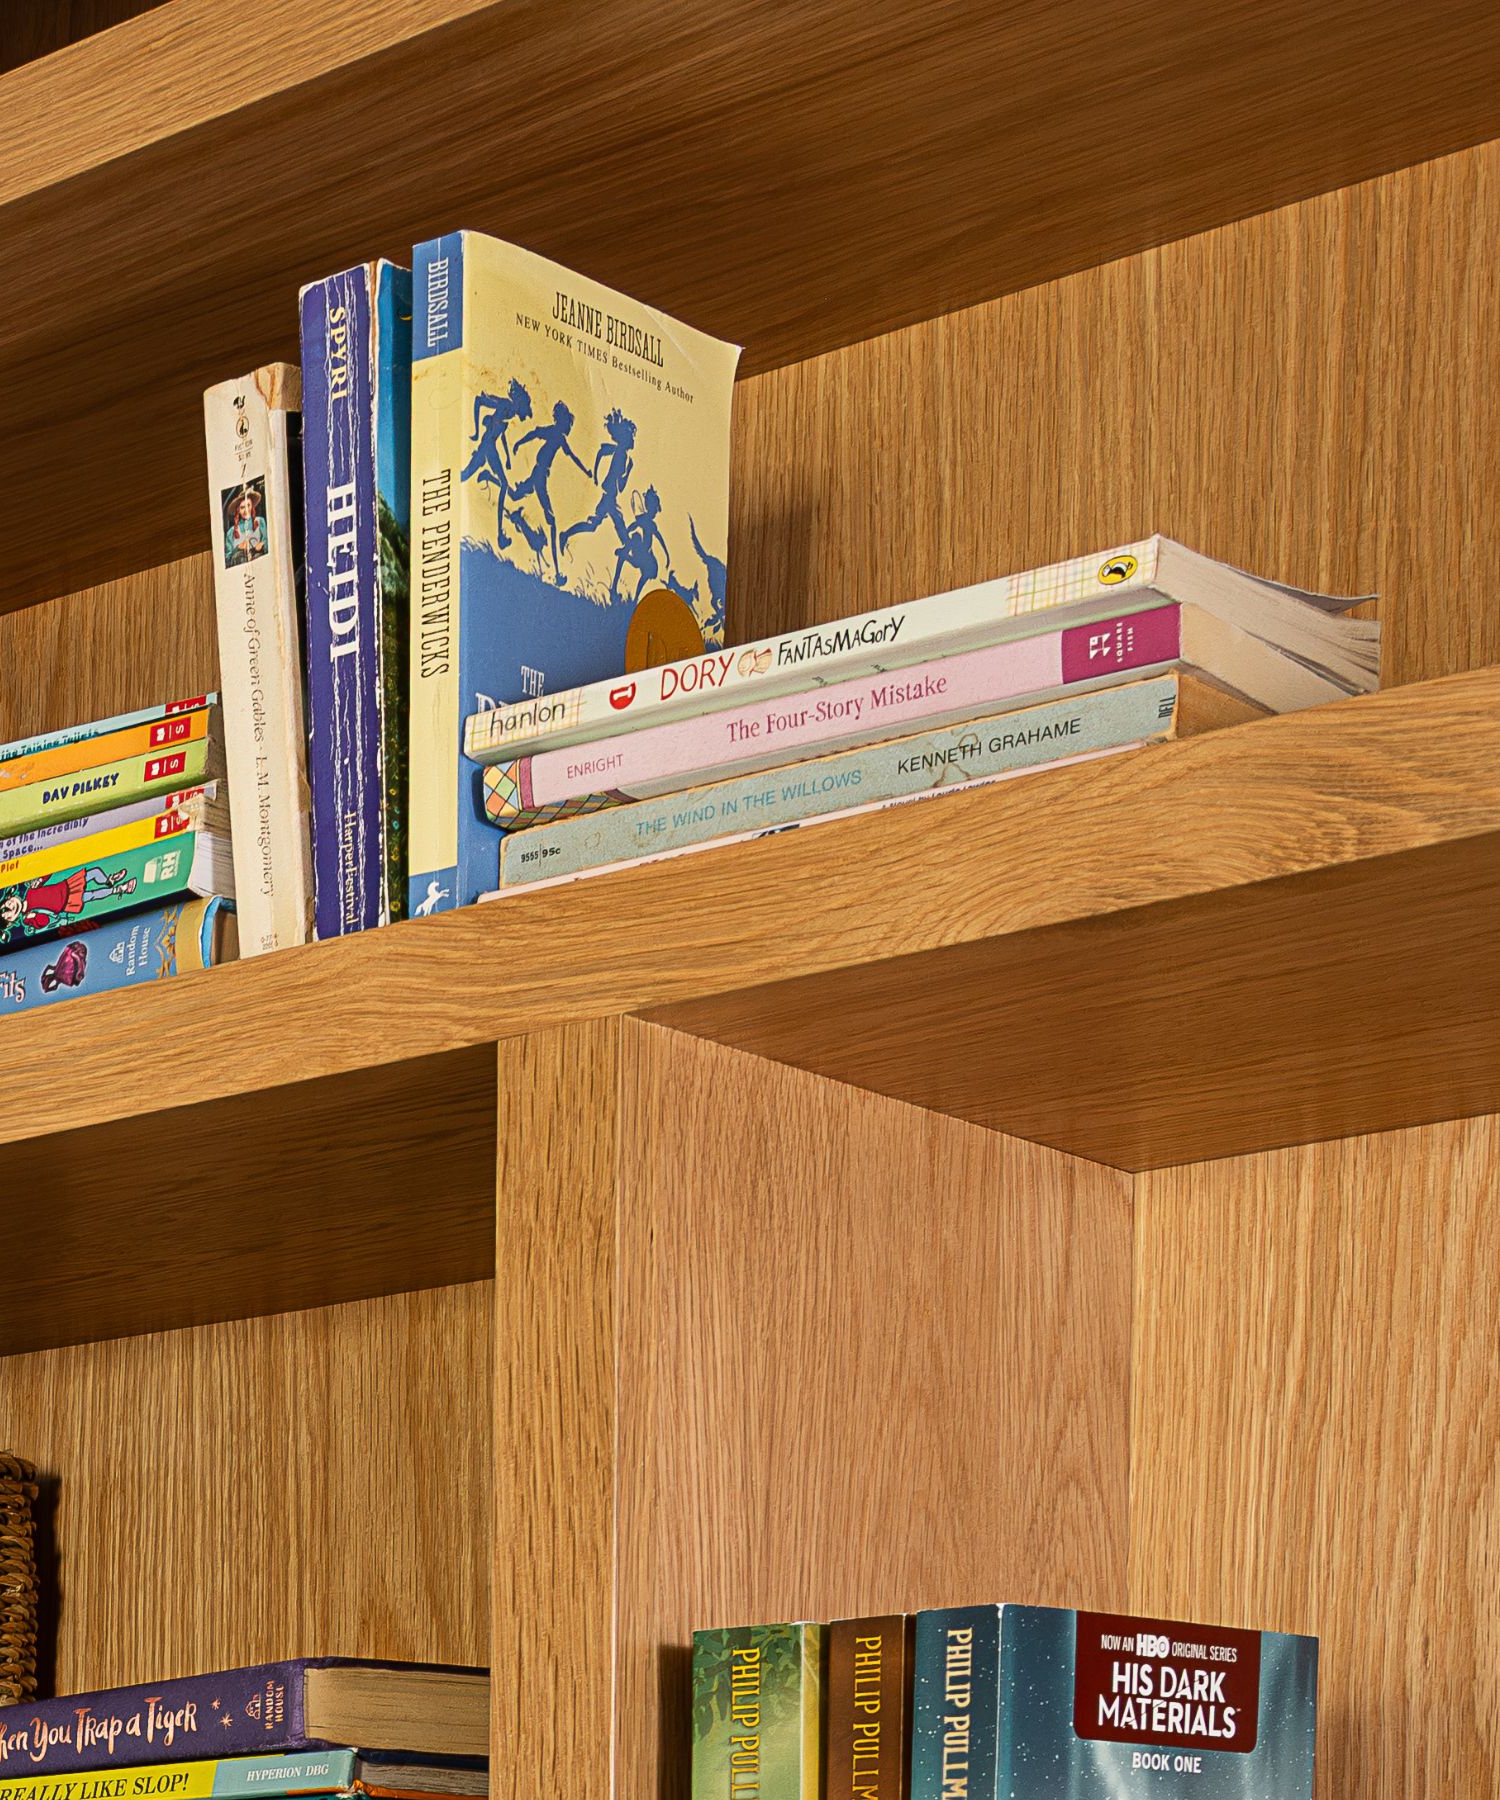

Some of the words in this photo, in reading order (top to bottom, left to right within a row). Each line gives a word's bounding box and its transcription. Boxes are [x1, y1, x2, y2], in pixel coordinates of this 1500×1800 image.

[427, 258, 449, 348] BIRDSALL
[552, 291, 601, 338] JEANNE
[606, 314, 663, 368] BIRDSALL
[329, 305, 345, 402] SPYRI
[516, 313, 540, 332] NEW
[545, 325, 572, 348] YORK
[577, 339, 608, 363] TIMES
[612, 356, 662, 390] Bestselling
[665, 381, 694, 403] Author
[422, 469, 451, 517] THE
[420, 520, 450, 679] PENDERWICKS
[489, 700, 566, 738] hanlon
[659, 650, 735, 701] DORY
[726, 714, 759, 744] The
[764, 694, 864, 740] Four-Story
[868, 673, 948, 711] Mistake
[566, 754, 624, 779] ENRIGHT
[896, 742, 982, 776] KENNETH
[989, 717, 1082, 758] GRAHAME
[42, 786, 69, 804] DAV
[71, 772, 120, 796] PILKEY
[636, 814, 669, 838] THE
[673, 803, 716, 831] WIND
[721, 798, 739, 820] IN
[743, 789, 778, 815] THE
[781, 769, 863, 808] WILLOWS
[1101, 1634, 1121, 1650] NOW
[1122, 1637, 1134, 1651] AN
[1136, 1633, 1170, 1658] HBO
[1172, 1642, 1208, 1660] ORIGINAL
[1209, 1646, 1237, 1662] SERIES
[1112, 1662, 1153, 1696] HIS
[1160, 1667, 1226, 1703] DARK
[1098, 1694, 1236, 1738] MATERIALS
[80, 1778, 127, 1799] LIKE
[132, 1773, 189, 1795] SLOP!
[246, 1766, 301, 1783] HYPERION
[304, 1764, 330, 1779] DBG
[1132, 1752, 1169, 1771] BOOK
[1174, 1755, 1201, 1773] ONE
